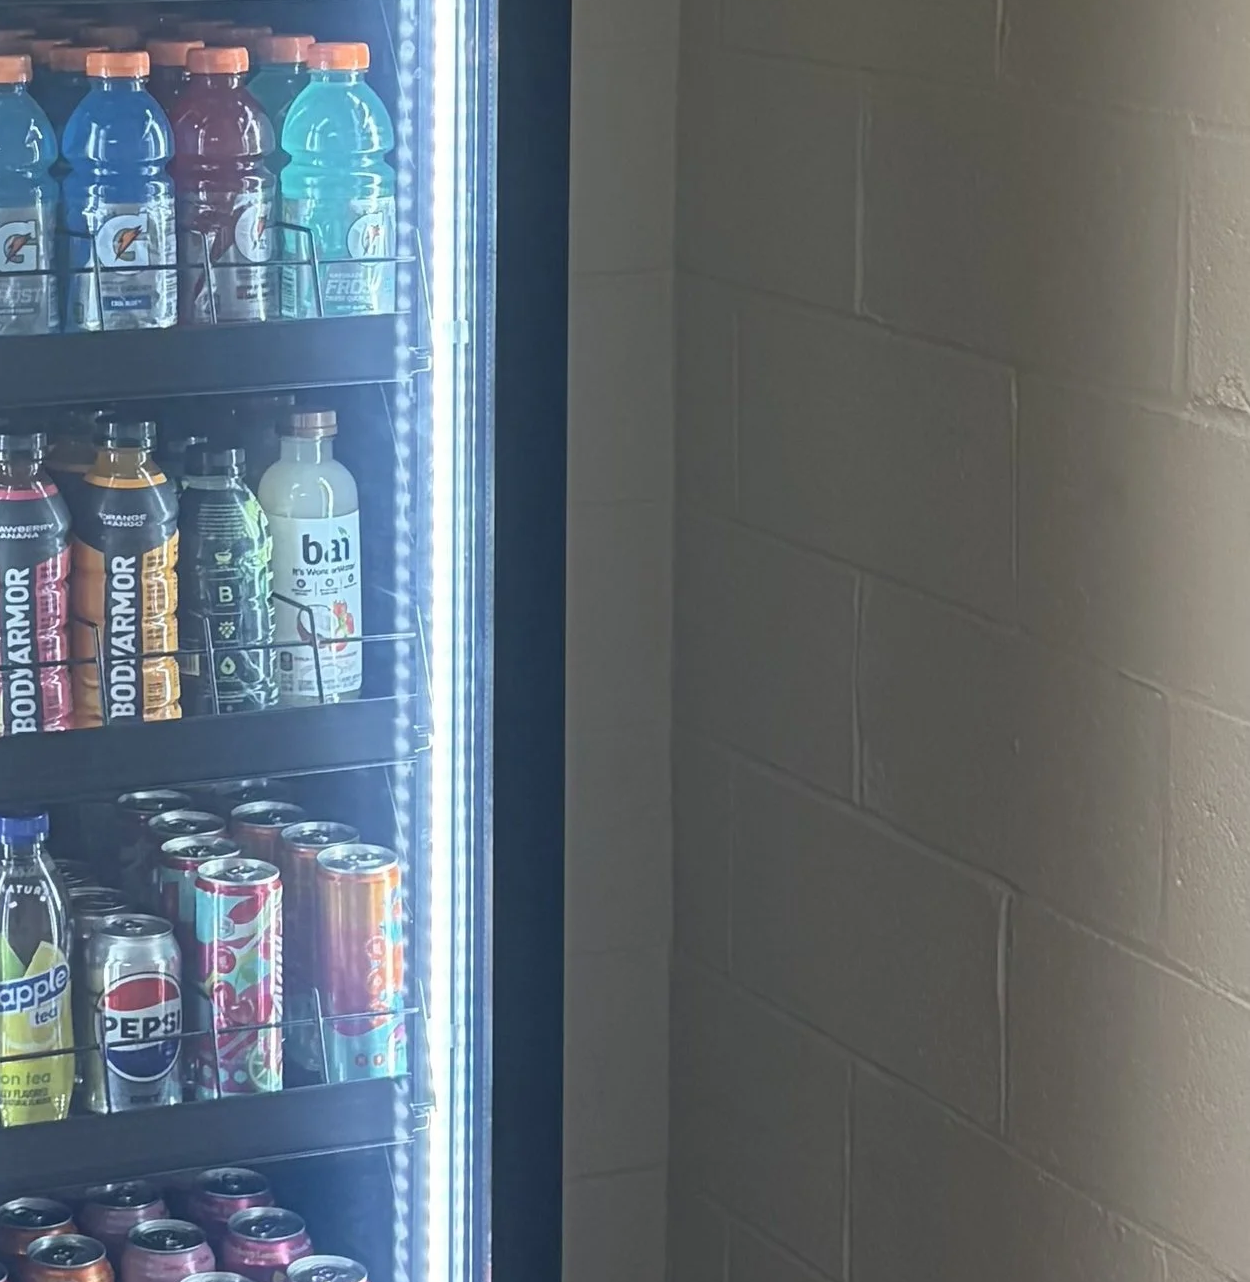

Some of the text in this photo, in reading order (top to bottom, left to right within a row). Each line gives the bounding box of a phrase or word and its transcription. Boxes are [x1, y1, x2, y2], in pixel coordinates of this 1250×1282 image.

[101, 513, 147, 523] ORANGE
[302, 532, 351, 566] bai
[292, 567, 304, 576] It's
[4, 567, 38, 735] BODYARMOR
[34, 1004, 58, 1025] tea
[105, 1009, 181, 1039] PEPSI
